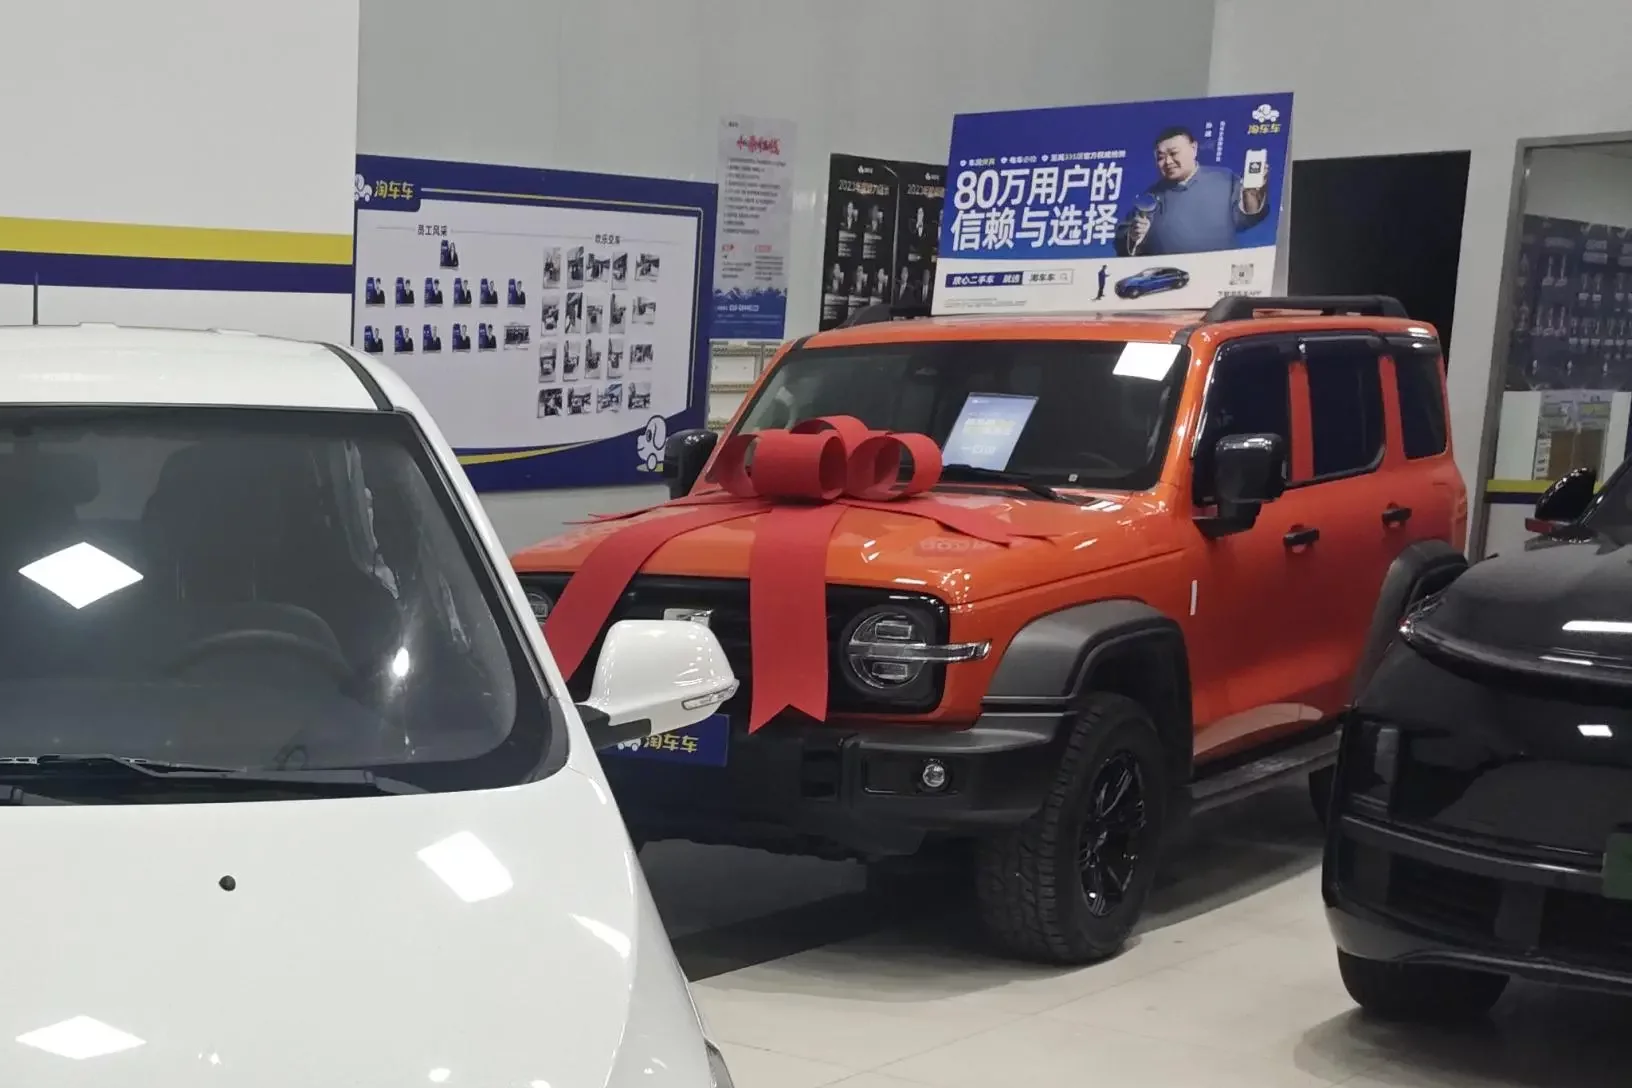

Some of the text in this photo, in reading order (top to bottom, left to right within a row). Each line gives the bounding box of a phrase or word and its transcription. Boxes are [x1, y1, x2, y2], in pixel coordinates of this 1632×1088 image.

[374, 179, 414, 200] 淘车车
[953, 161, 1123, 210] 80万用户的
[417, 224, 447, 237] 员工风采
[950, 203, 1118, 251] 信赖与选择
[643, 733, 699, 753] 淘车车
